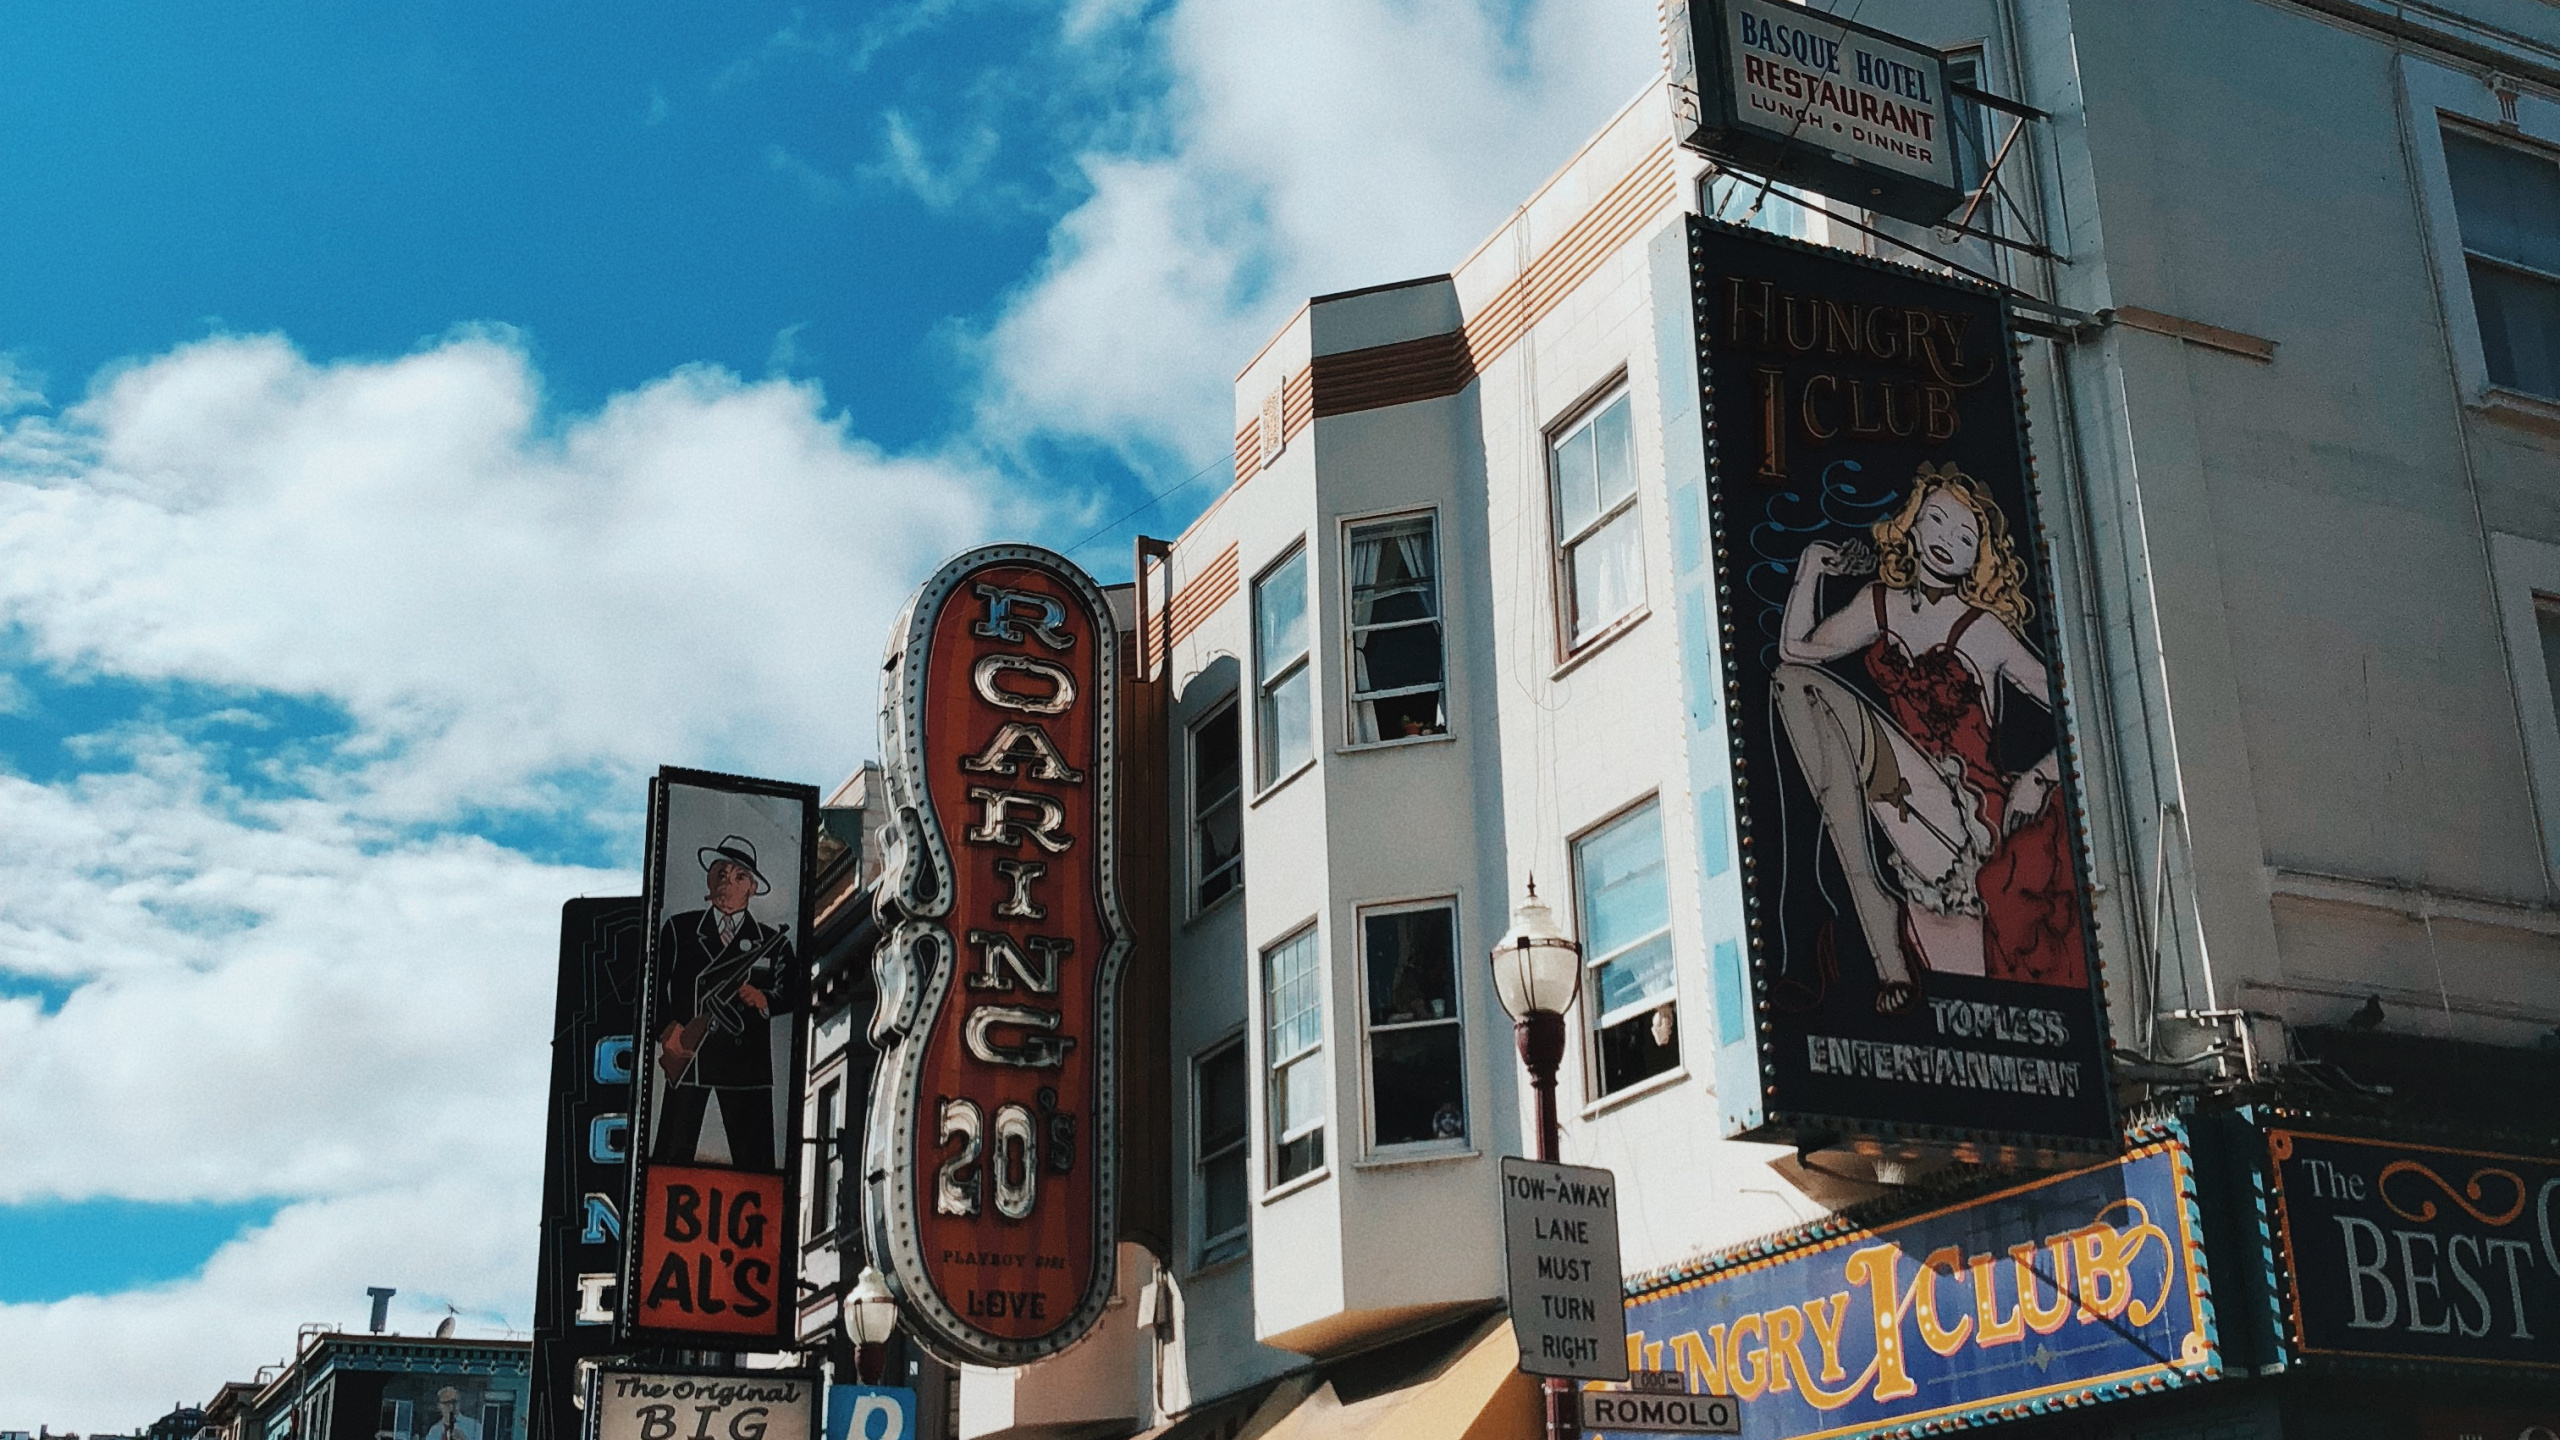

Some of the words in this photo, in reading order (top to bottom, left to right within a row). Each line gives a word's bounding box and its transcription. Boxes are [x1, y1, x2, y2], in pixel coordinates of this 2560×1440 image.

[1740, 11, 1840, 75] BASQUE
[1855, 49, 1933, 104] HOTEL
[1745, 53, 1934, 142] RESTAURANT
[1751, 94, 1823, 129] LUNCH
[1853, 126, 1933, 164] DINNER
[1725, 275, 1994, 388] HUNGRY
[1757, 366, 1788, 480] I
[1802, 374, 1960, 440] CLUB
[963, 583, 1083, 1068] ROARING
[1928, 999, 2069, 1047] TOPLESS
[1806, 1034, 2081, 1098] ENTERTAINMENT
[1507, 1174, 1610, 1208] TOW-AWAY
[2301, 1157, 2367, 1201] The
[664, 1183, 769, 1250] BIG
[1534, 1217, 1590, 1245] LANE
[646, 1247, 772, 1318] AL'S
[1538, 1256, 1591, 1283] MUST
[2332, 1215, 2536, 1340] BEST
[966, 1289, 1047, 1320] LOVE
[1541, 1294, 1596, 1322] TURN
[1845, 1244, 1918, 1401] I
[1915, 1210, 2146, 1356] CLUB
[1542, 1335, 1598, 1362] RIGHT
[615, 1376, 670, 1400] The
[672, 1379, 800, 1406] Original
[1595, 1399, 1729, 1427] ROMOLO
[636, 1404, 770, 1440] BIG
